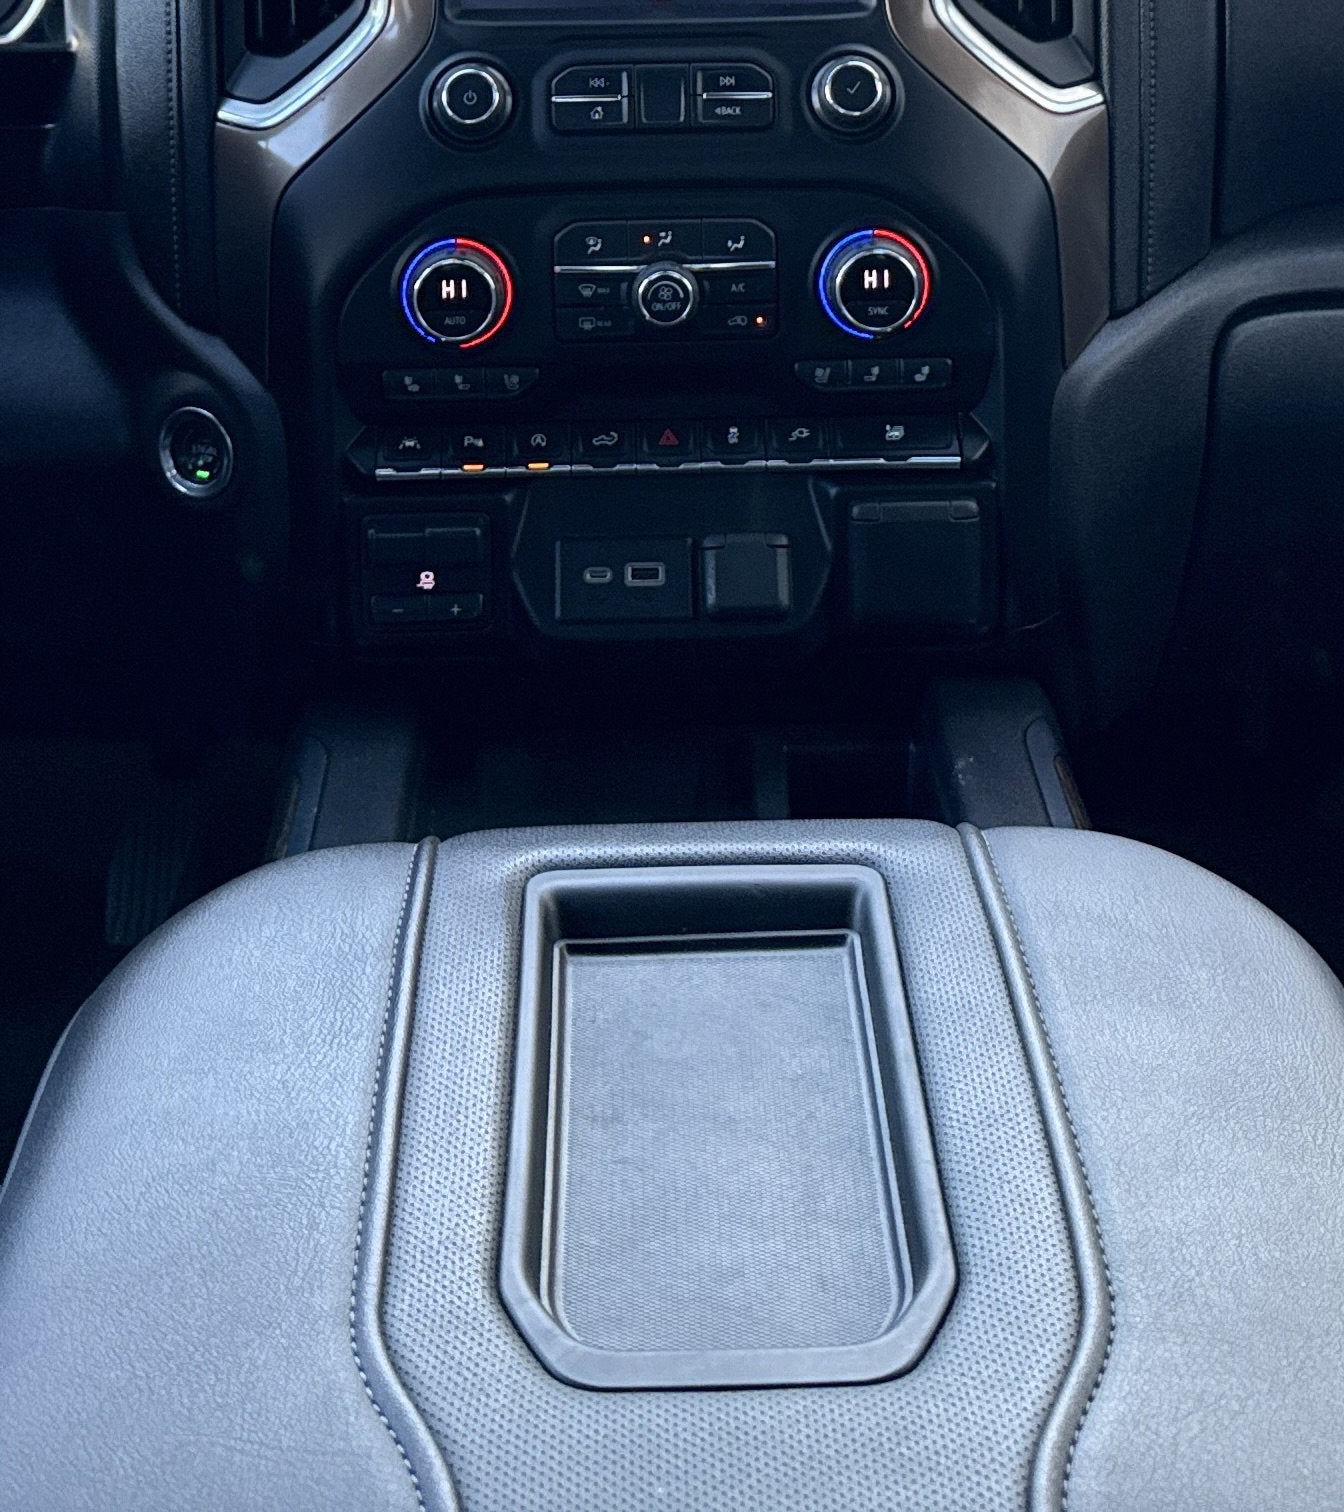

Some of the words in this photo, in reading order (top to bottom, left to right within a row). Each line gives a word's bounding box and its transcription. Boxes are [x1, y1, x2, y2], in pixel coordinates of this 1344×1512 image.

[721, 106, 741, 116] BACK
[863, 269, 890, 290] HI
[440, 279, 467, 300] HI
[731, 283, 745, 293] A/C
[651, 302, 681, 312] ON/OFF
[868, 306, 889, 317] SYNC
[444, 316, 466, 326] AUTO
